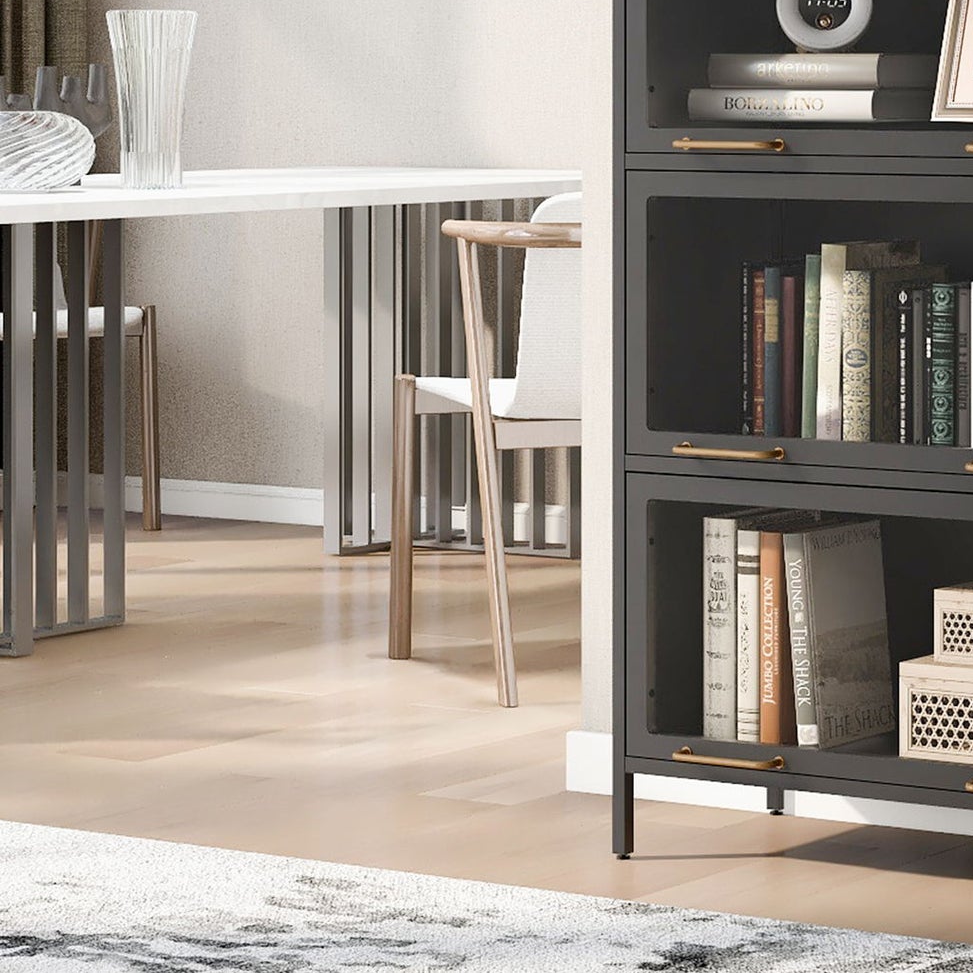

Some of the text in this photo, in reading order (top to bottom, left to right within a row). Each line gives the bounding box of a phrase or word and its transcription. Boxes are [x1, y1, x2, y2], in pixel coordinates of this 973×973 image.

[823, 289, 838, 364] AFTER DAYS
[789, 558, 804, 610] YOUNG
[762, 576, 776, 704] JUMBO COLLECTION
[792, 626, 811, 707] THE SHACK
[824, 705, 897, 739] THE SHACK
